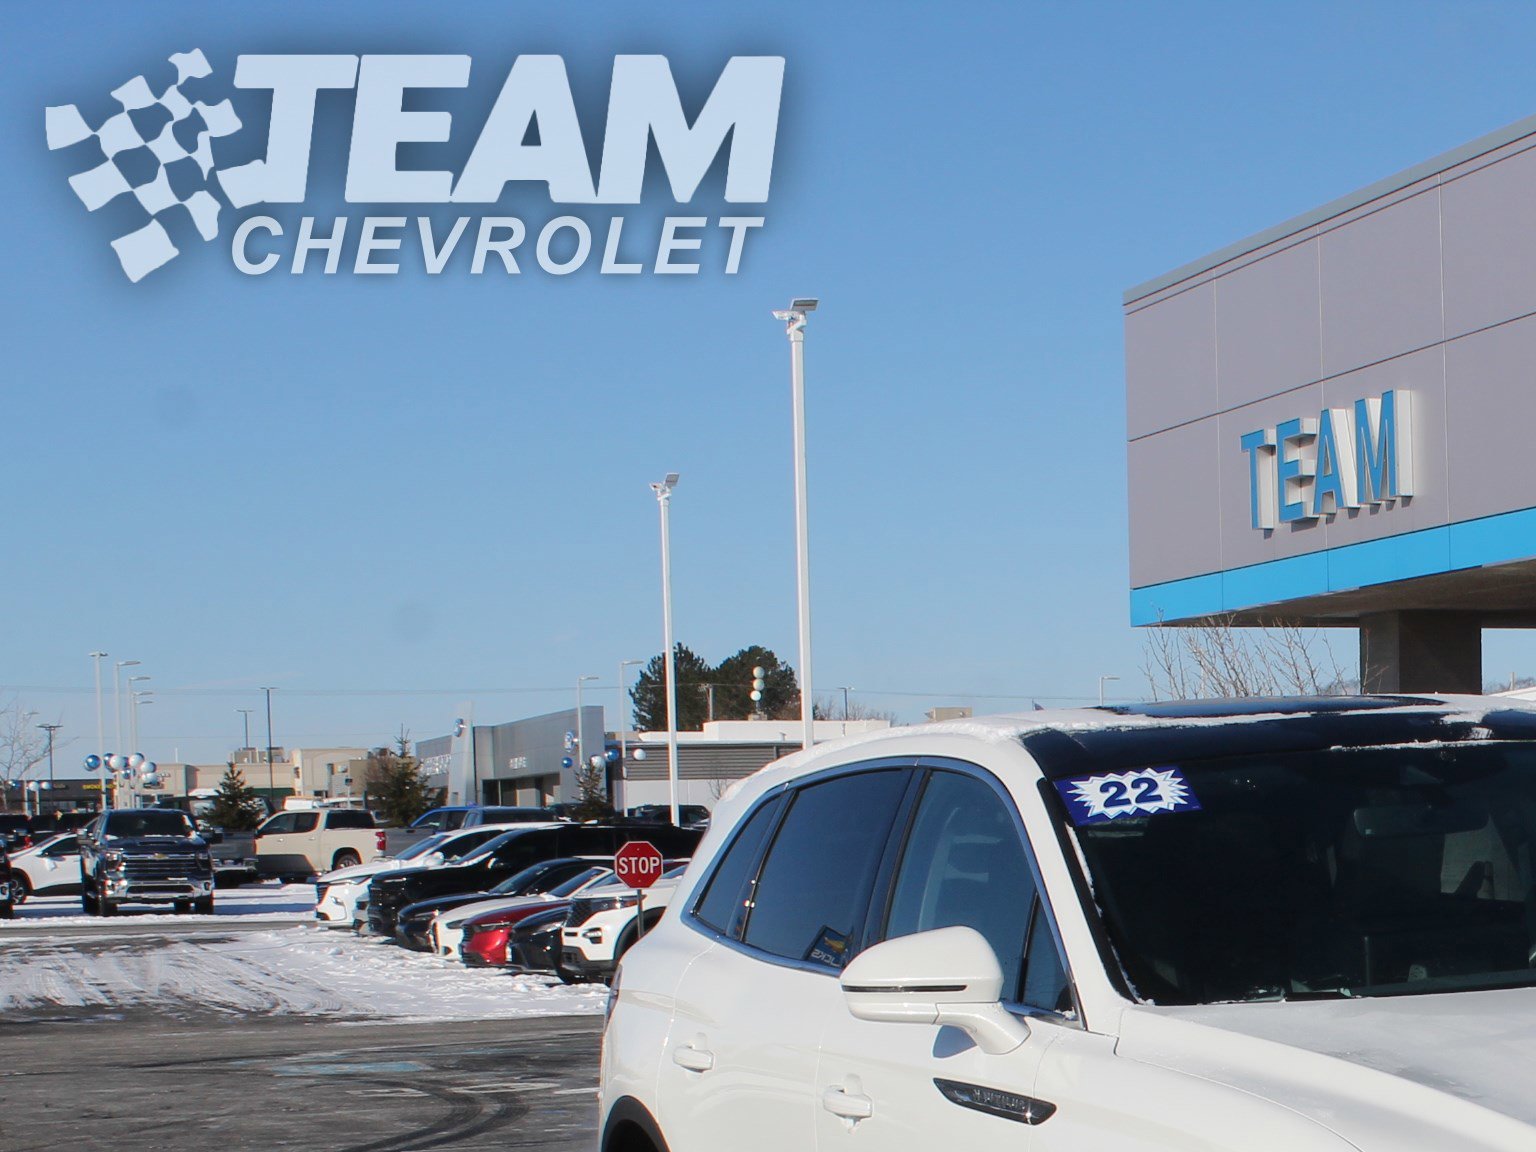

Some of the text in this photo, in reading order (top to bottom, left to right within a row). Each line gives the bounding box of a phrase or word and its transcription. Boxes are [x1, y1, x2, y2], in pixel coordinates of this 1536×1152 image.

[1240, 389, 1412, 530] TEAM
[1100, 777, 1163, 808] 22
[618, 856, 660, 875] STOP
